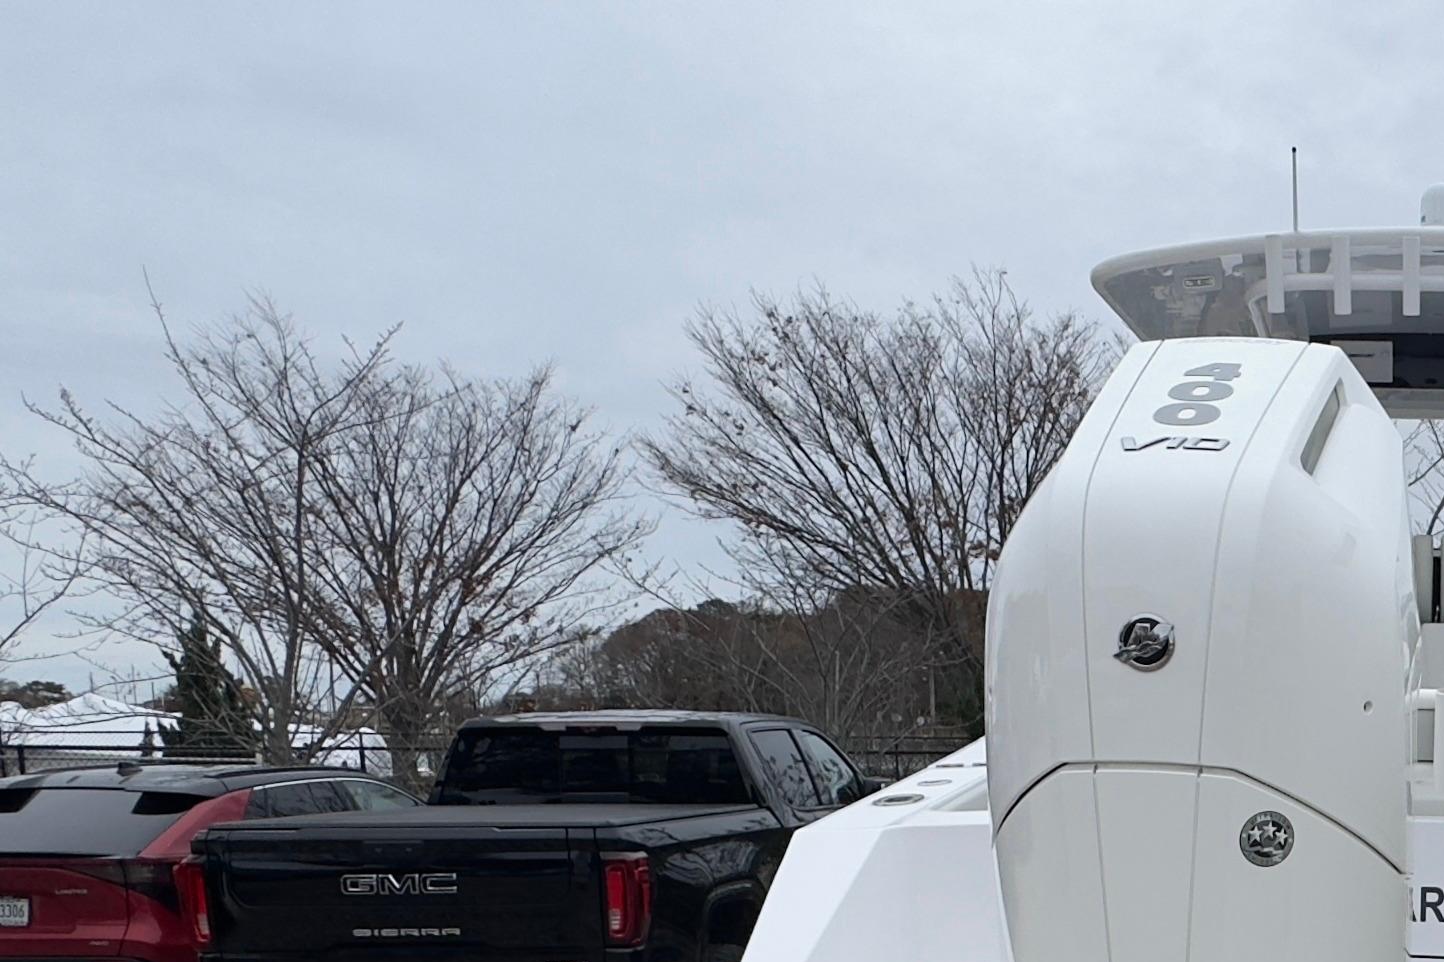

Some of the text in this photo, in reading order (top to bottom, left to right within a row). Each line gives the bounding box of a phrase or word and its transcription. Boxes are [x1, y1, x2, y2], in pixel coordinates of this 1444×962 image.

[1120, 436, 1231, 451] V10
[340, 872, 458, 895] GMC
[352, 927, 461, 937] SIERRA
